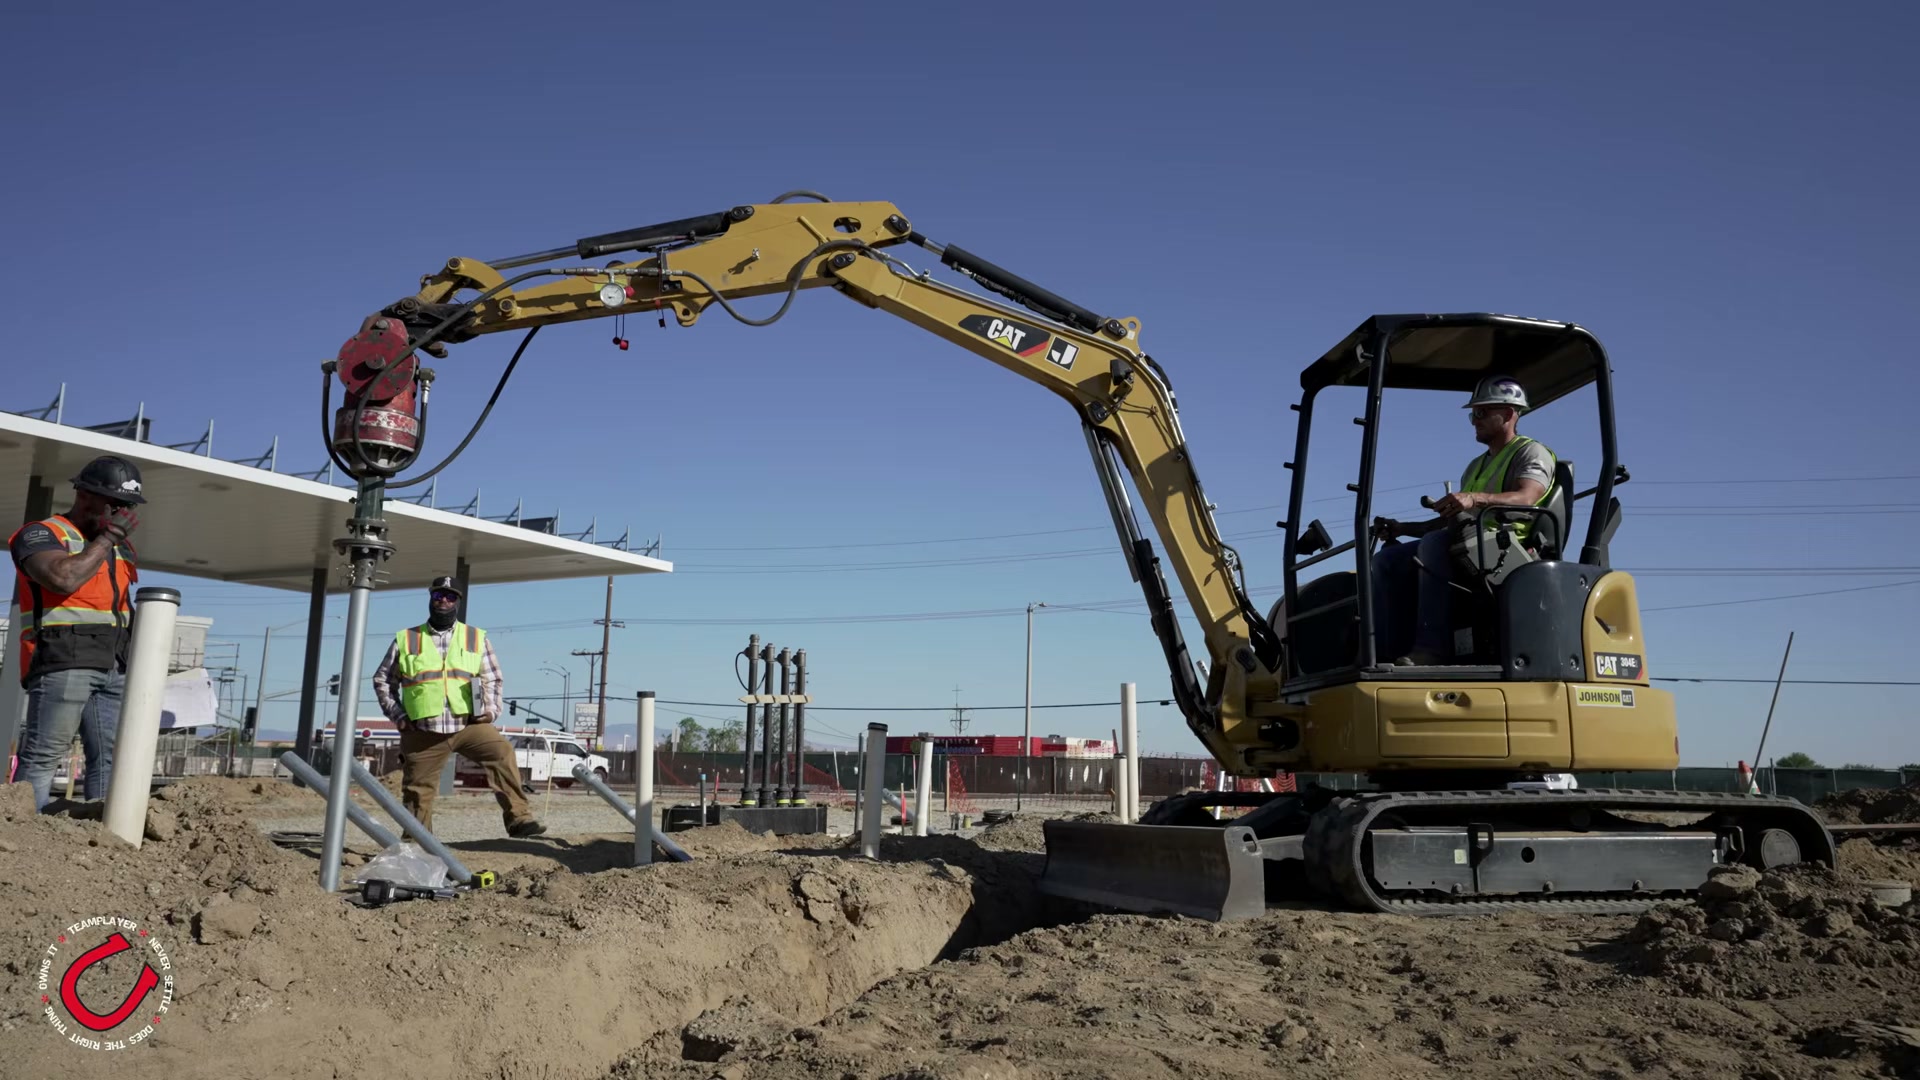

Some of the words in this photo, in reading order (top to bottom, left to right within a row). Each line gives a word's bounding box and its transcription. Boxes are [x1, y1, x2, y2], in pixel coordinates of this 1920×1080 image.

[987, 319, 1026, 351] CAT
[1596, 655, 1617, 675] CAT
[1579, 691, 1621, 703] JOHNSON
[1622, 694, 1632, 703] CAT
